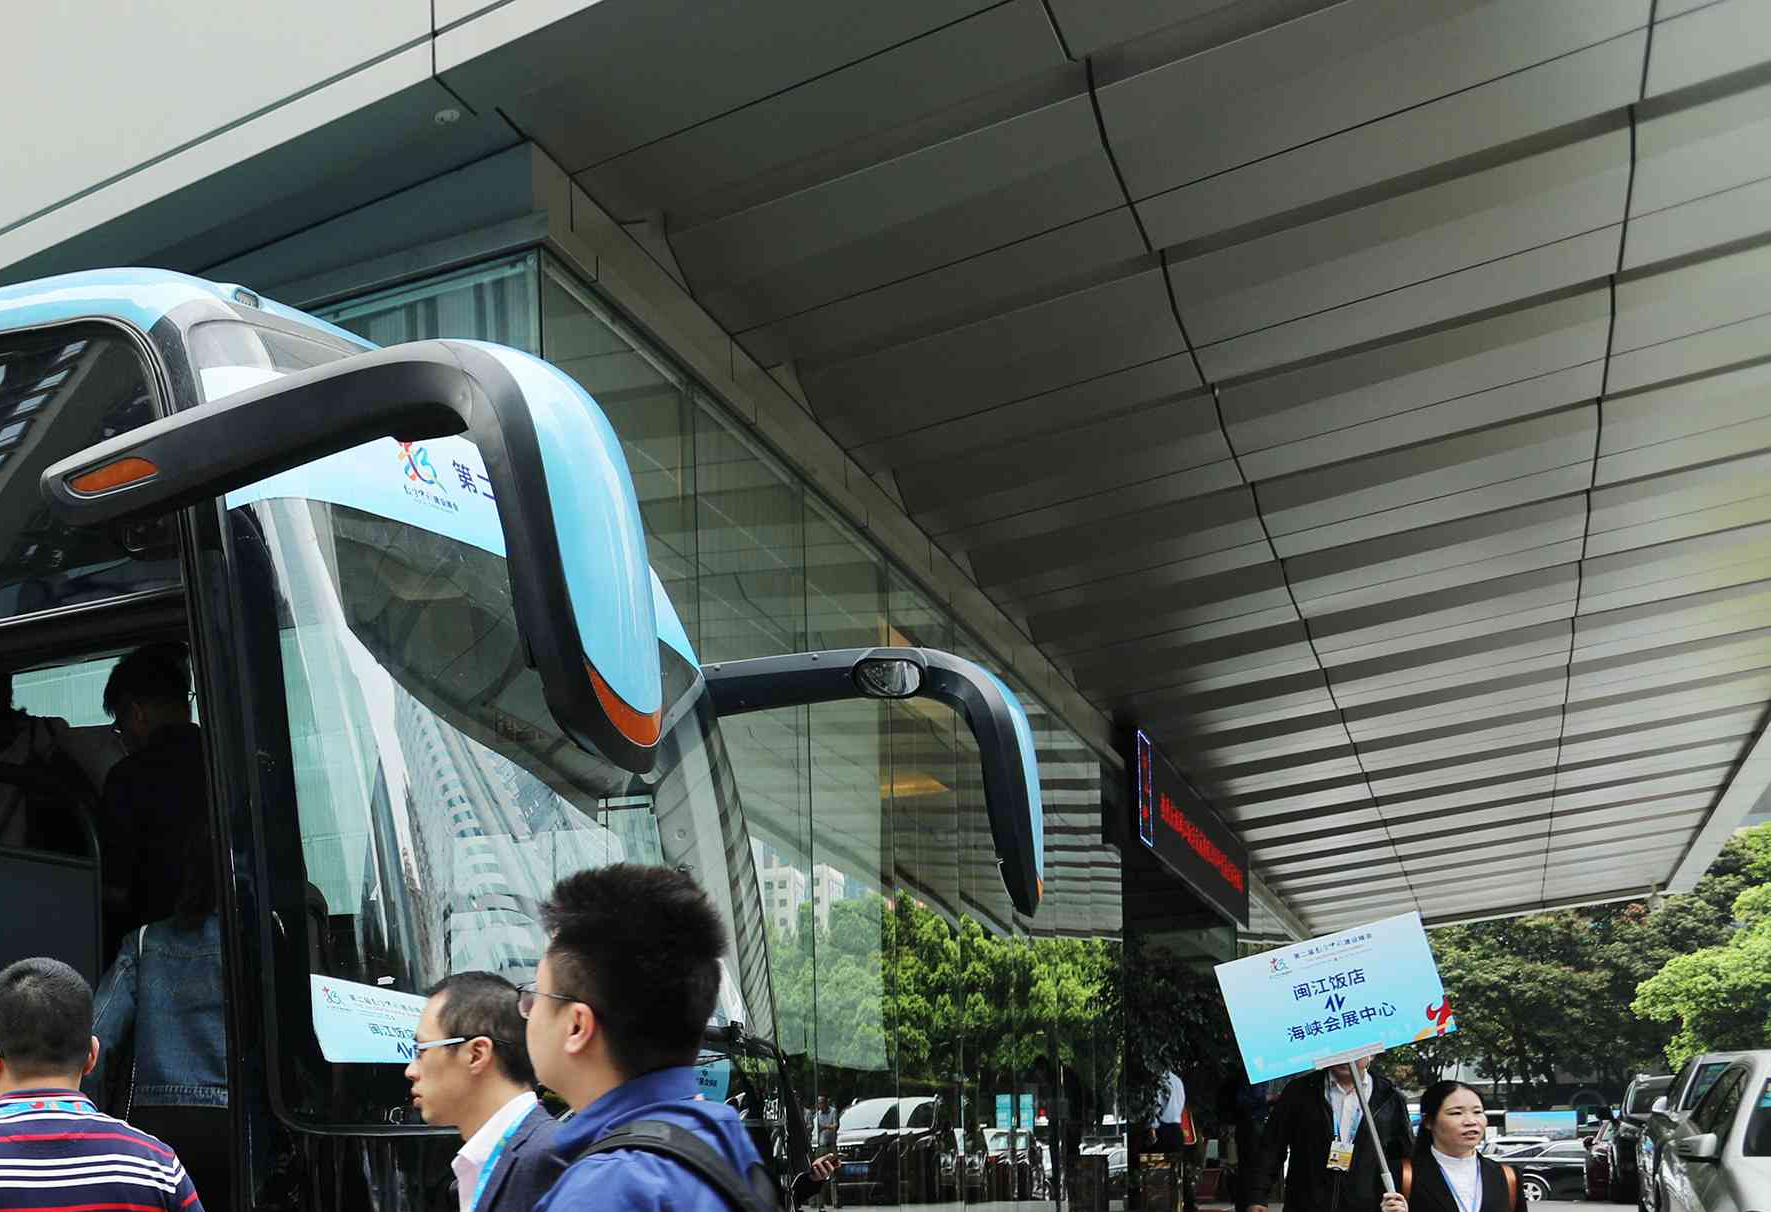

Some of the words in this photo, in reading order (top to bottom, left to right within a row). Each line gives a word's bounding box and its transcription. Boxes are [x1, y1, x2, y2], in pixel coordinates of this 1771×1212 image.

[1292, 967, 1366, 1001] 闽江饭店
[1286, 1001, 1397, 1043] 海峡会展中心
